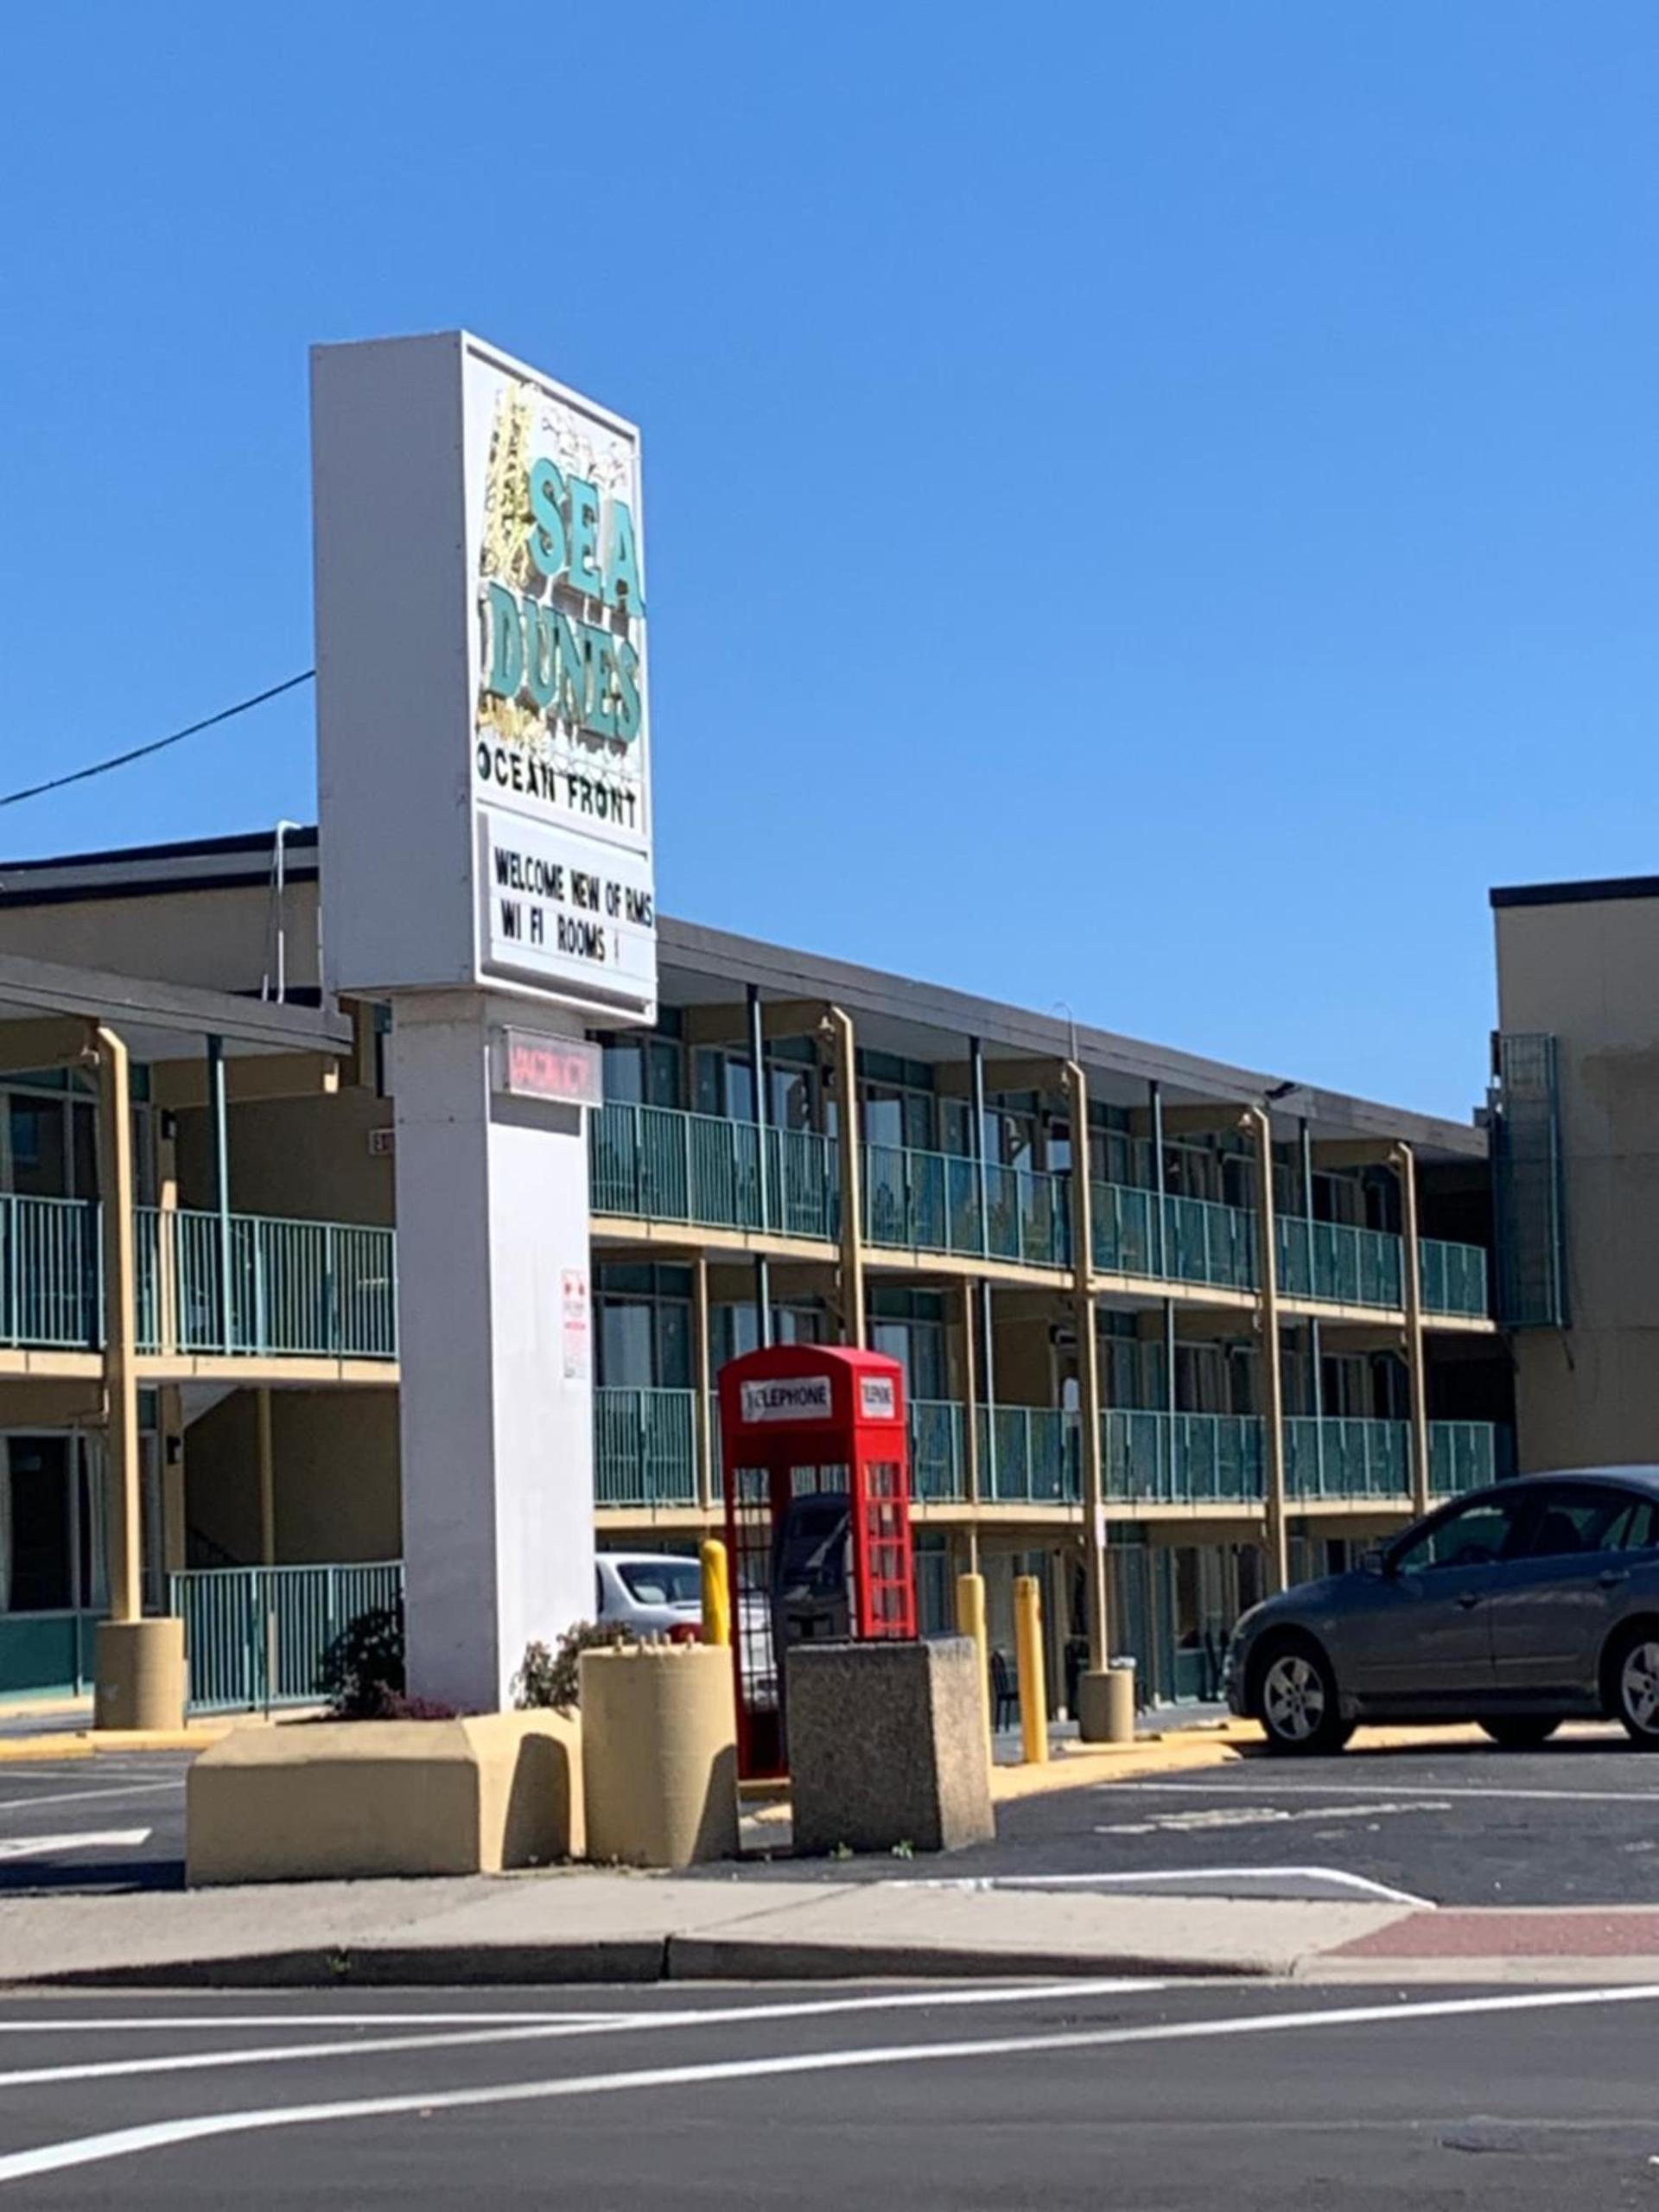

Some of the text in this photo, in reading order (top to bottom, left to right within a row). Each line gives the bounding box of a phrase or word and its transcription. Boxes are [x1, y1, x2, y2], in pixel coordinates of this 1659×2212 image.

[527, 457, 645, 618] SEA
[488, 581, 642, 743] DUNES
[477, 741, 636, 828] OCEAN FRONT
[495, 846, 564, 902] WELCOME
[570, 868, 600, 912] NEW
[625, 887, 653, 928] RMS
[501, 898, 521, 941] WI
[531, 906, 543, 944] FI
[557, 913, 605, 962] ROOMS
